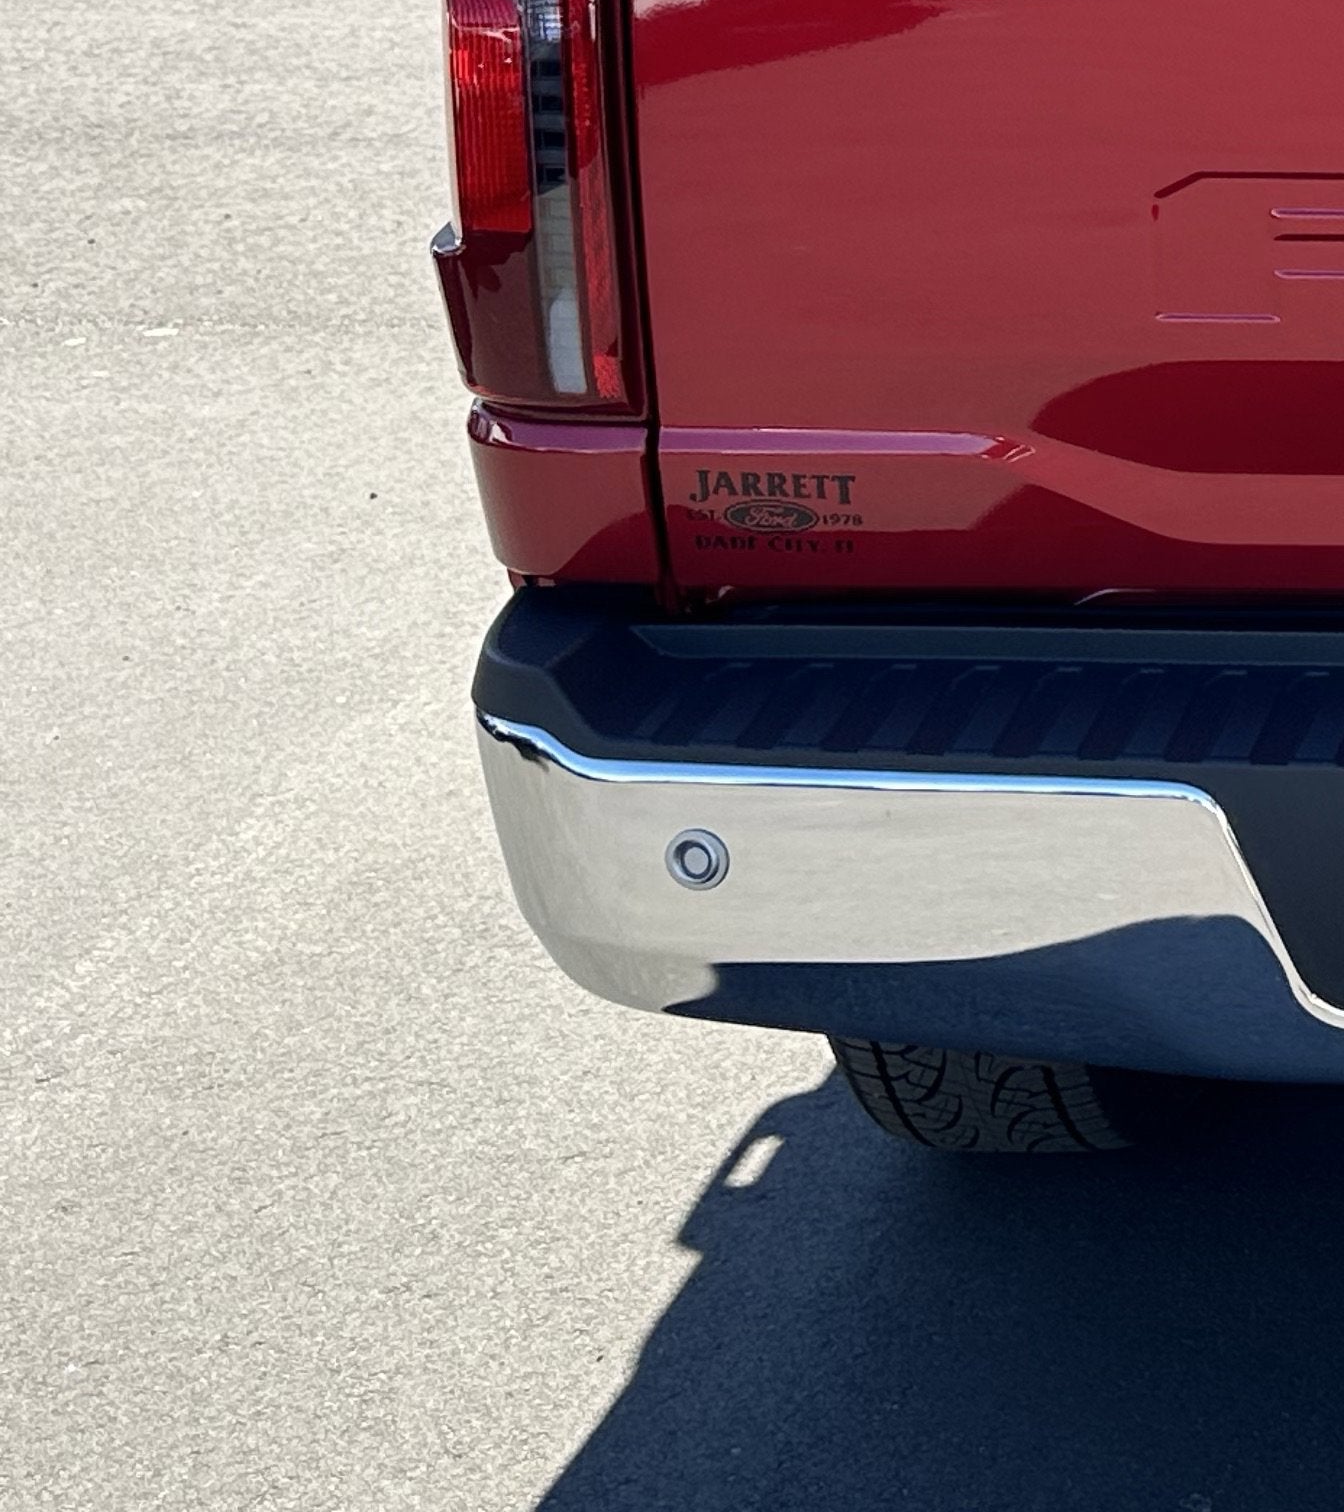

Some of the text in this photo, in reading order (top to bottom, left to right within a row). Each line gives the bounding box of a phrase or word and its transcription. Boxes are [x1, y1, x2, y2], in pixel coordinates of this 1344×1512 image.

[689, 469, 856, 505] JARRETT
[744, 505, 798, 529] Ford
[822, 513, 864, 526] 1978
